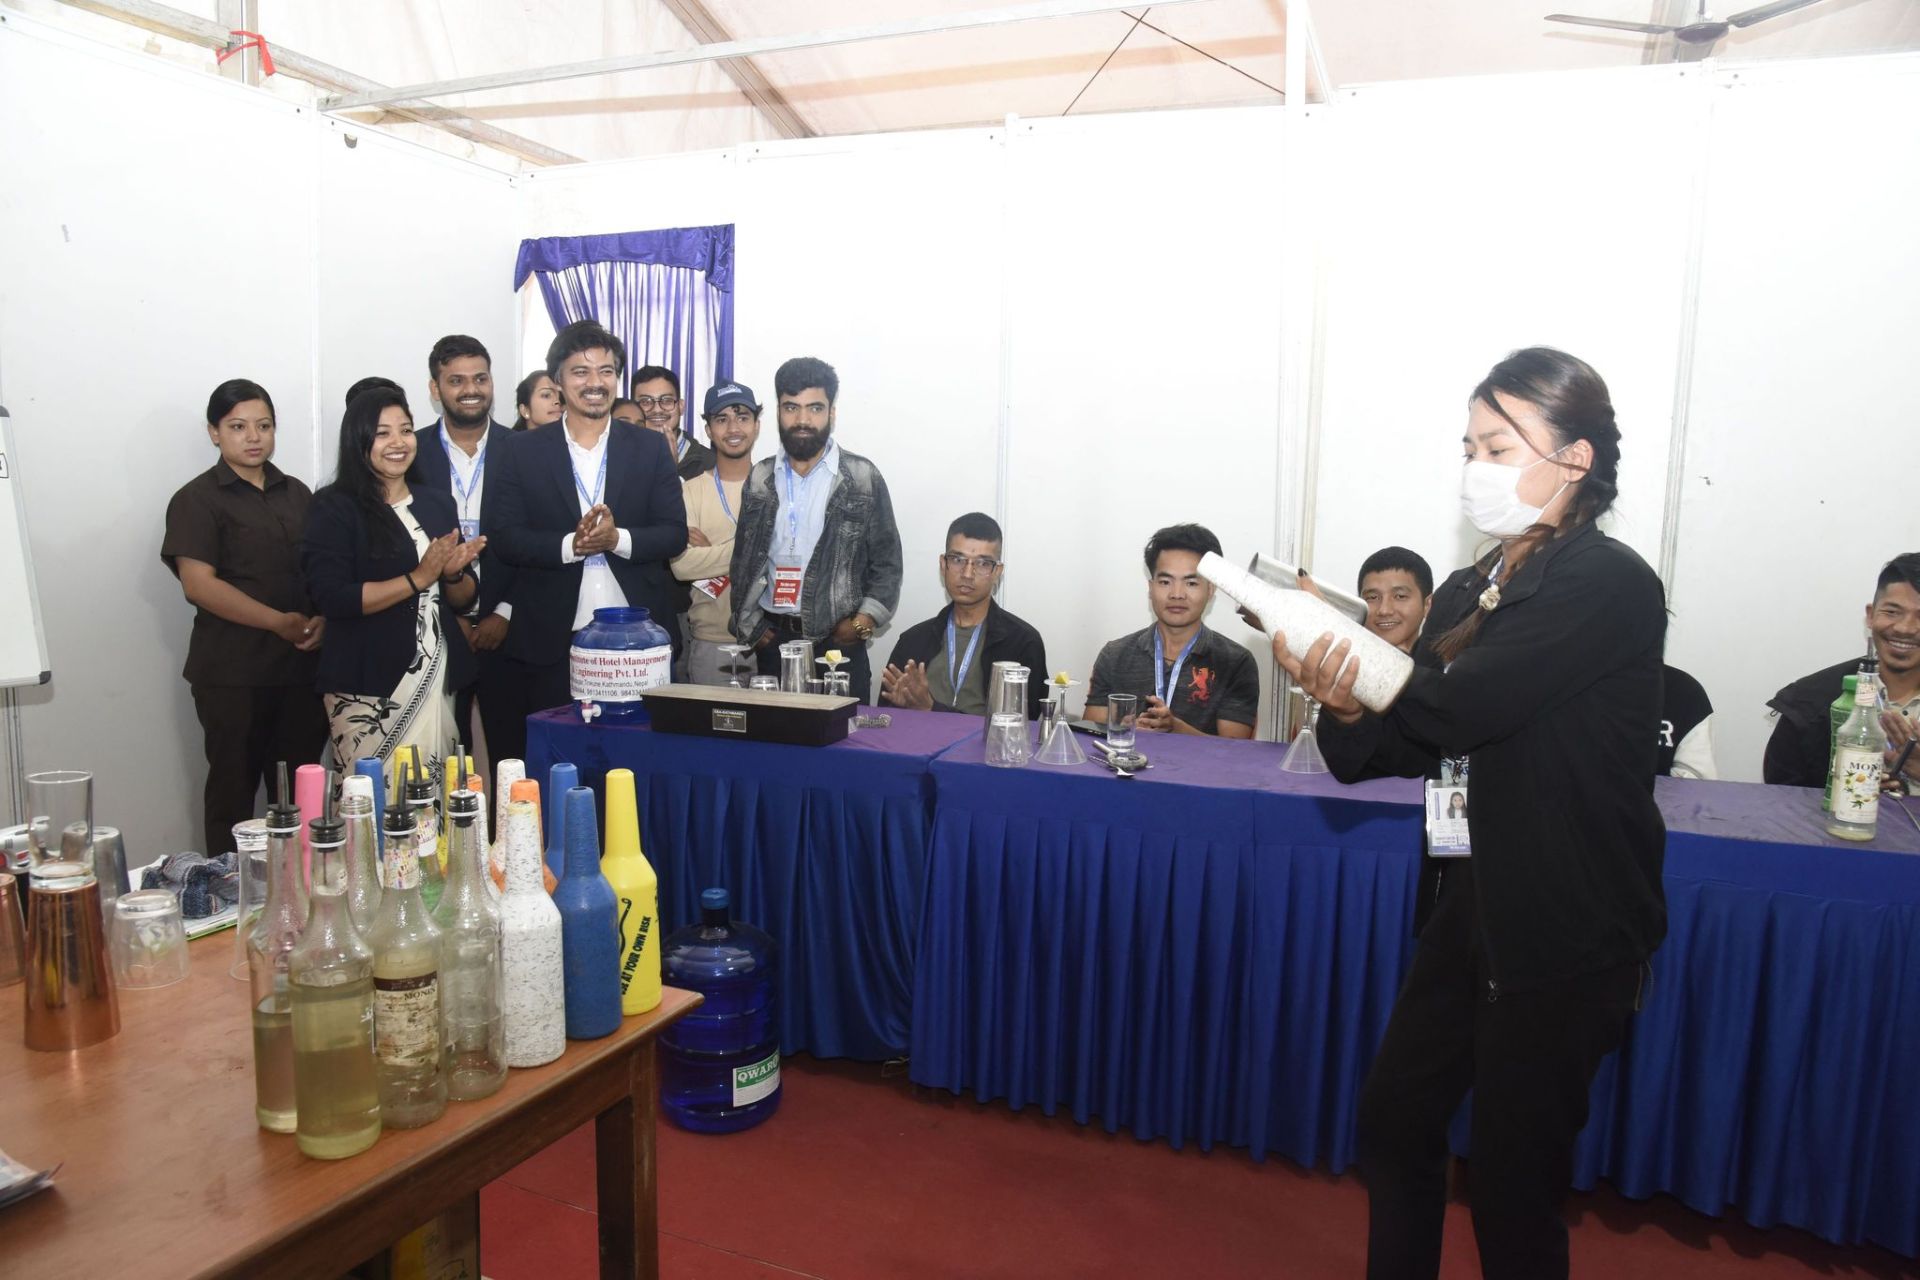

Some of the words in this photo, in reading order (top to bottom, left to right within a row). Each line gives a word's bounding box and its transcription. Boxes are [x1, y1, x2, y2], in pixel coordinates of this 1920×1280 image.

[599, 657, 620, 666] Hotel
[623, 655, 667, 665] Management
[615, 669, 631, 678] Pvt.
[633, 668, 649, 677] Ltd.
[639, 916, 651, 933] RISK
[633, 934, 646, 952] OWN
[624, 952, 640, 972] YOUR
[620, 972, 633, 983] AT
